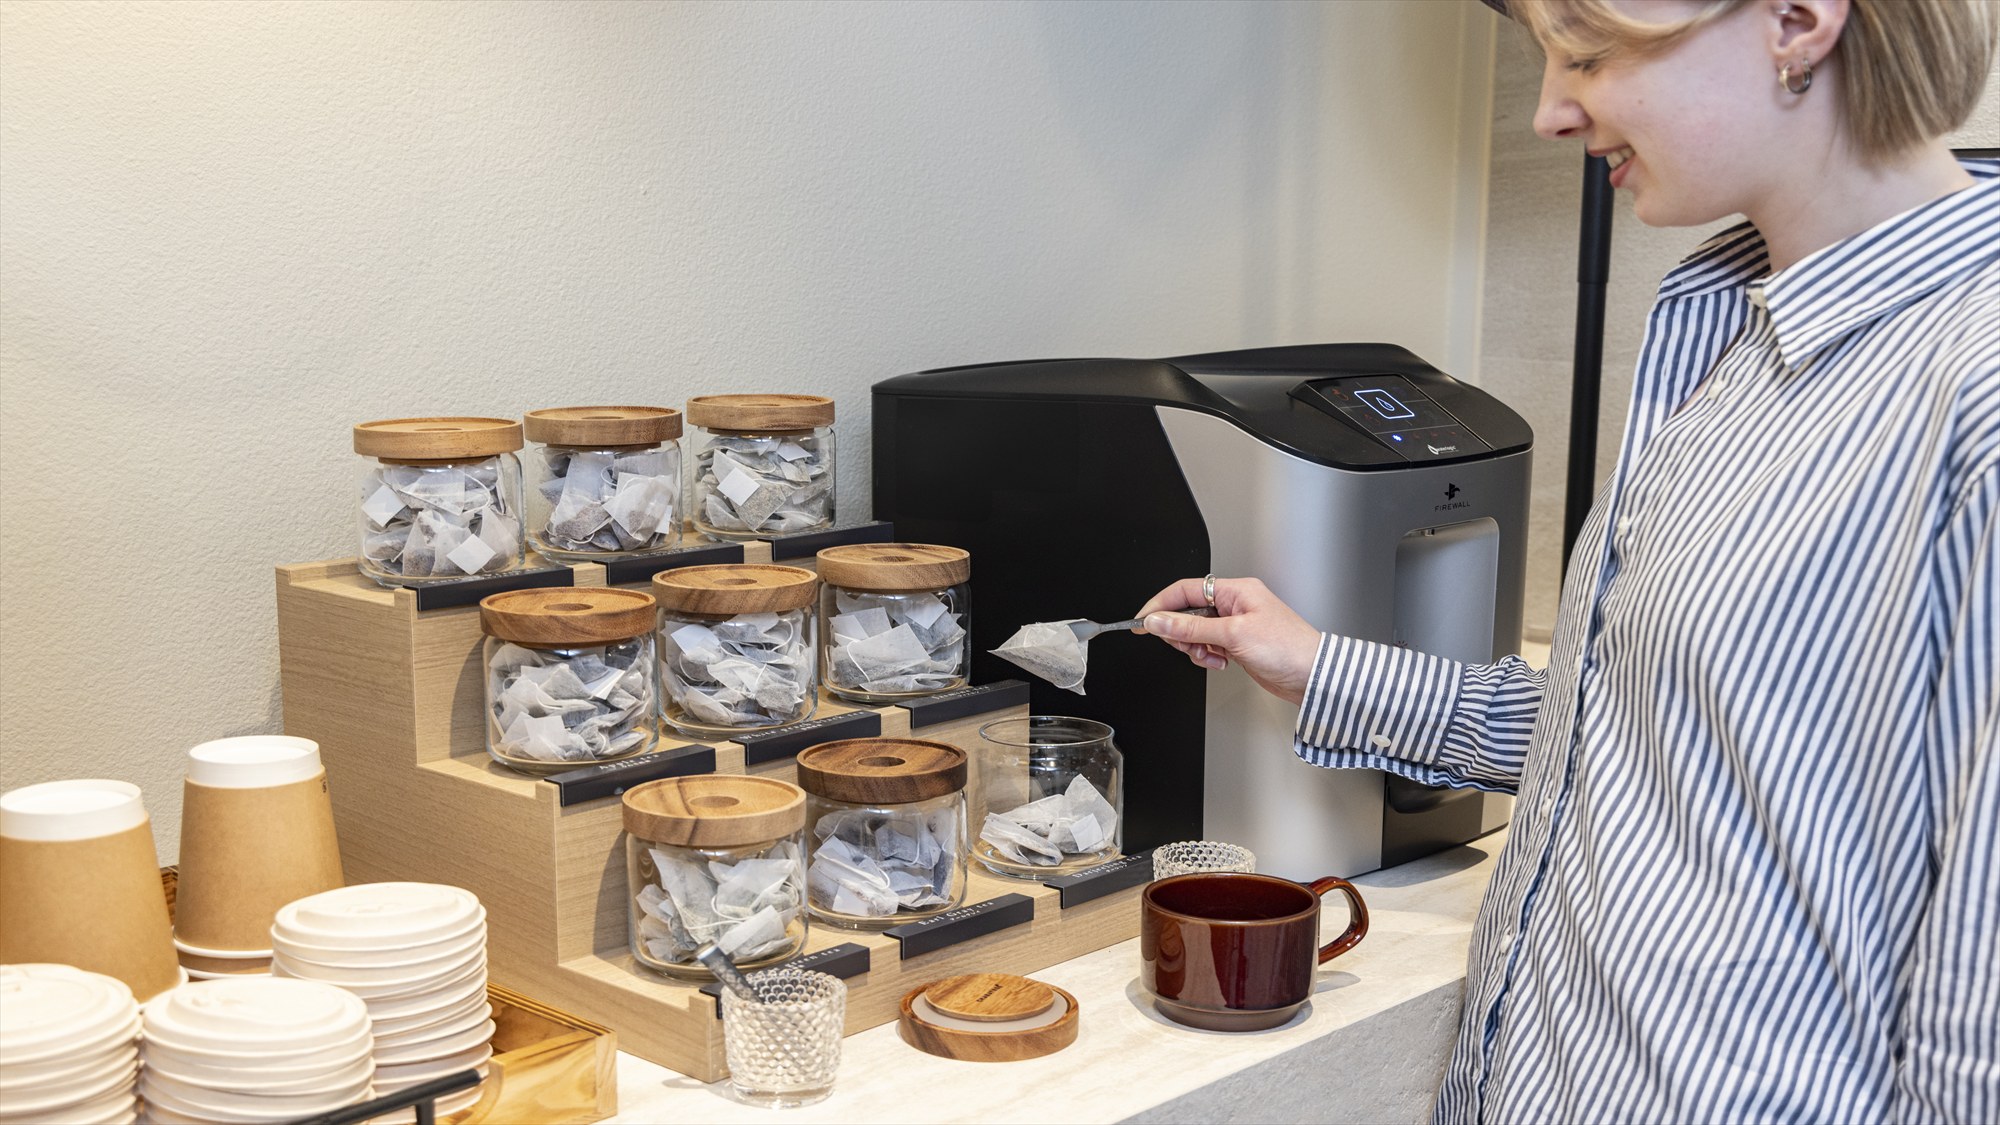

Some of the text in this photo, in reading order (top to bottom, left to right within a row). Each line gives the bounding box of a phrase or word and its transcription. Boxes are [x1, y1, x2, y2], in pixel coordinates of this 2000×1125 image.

[1434, 501, 1471, 512] FIREWALL
[739, 729, 776, 740] White
[1072, 854, 1142, 878] Darjeeling tea
[918, 915, 945, 926] Earl
[976, 900, 995, 909] tea
[820, 946, 841, 957] tea
